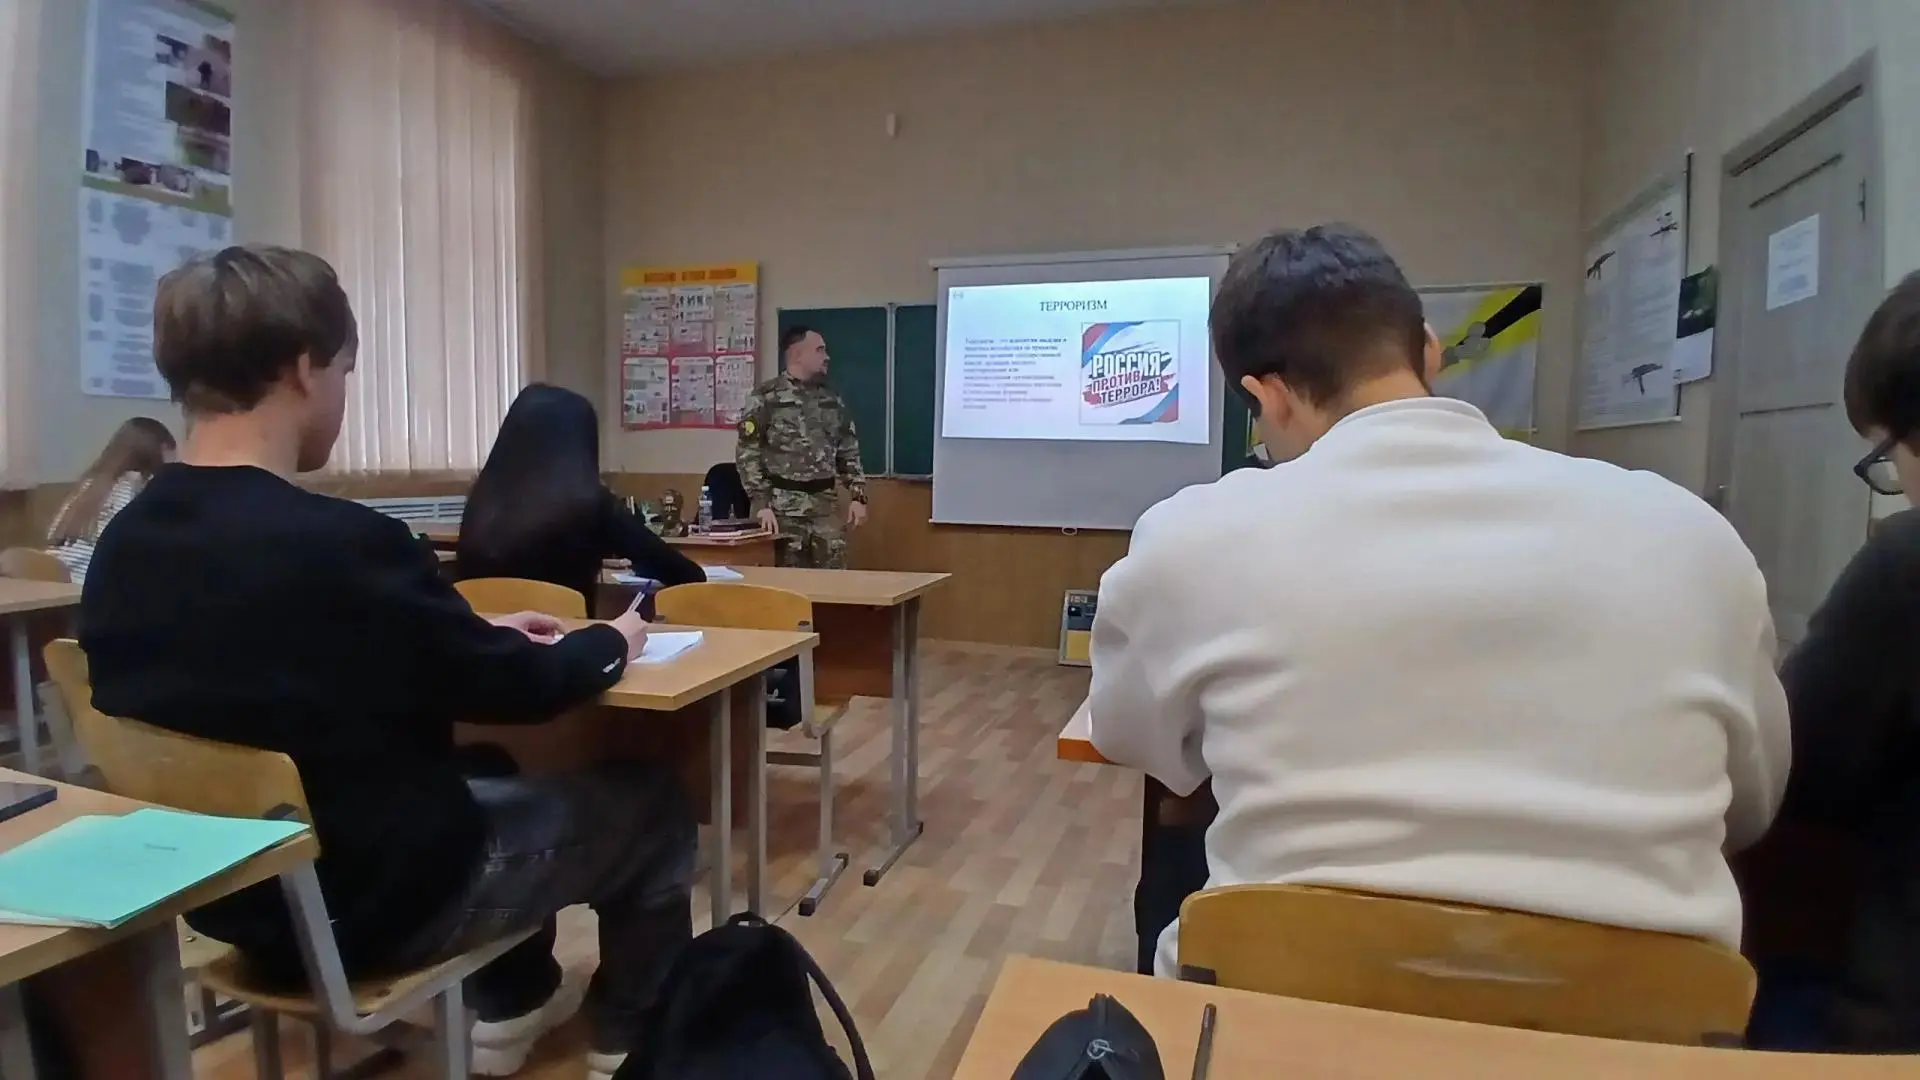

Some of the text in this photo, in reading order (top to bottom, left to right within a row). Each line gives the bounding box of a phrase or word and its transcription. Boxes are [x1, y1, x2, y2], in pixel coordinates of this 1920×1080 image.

[1039, 299, 1107, 312] ТЕРРОРИЗМ
[1091, 351, 1161, 378] РОССИЯ
[1092, 370, 1143, 393] ПРОТИВ
[1101, 378, 1160, 404] ТЕРРОРА!
